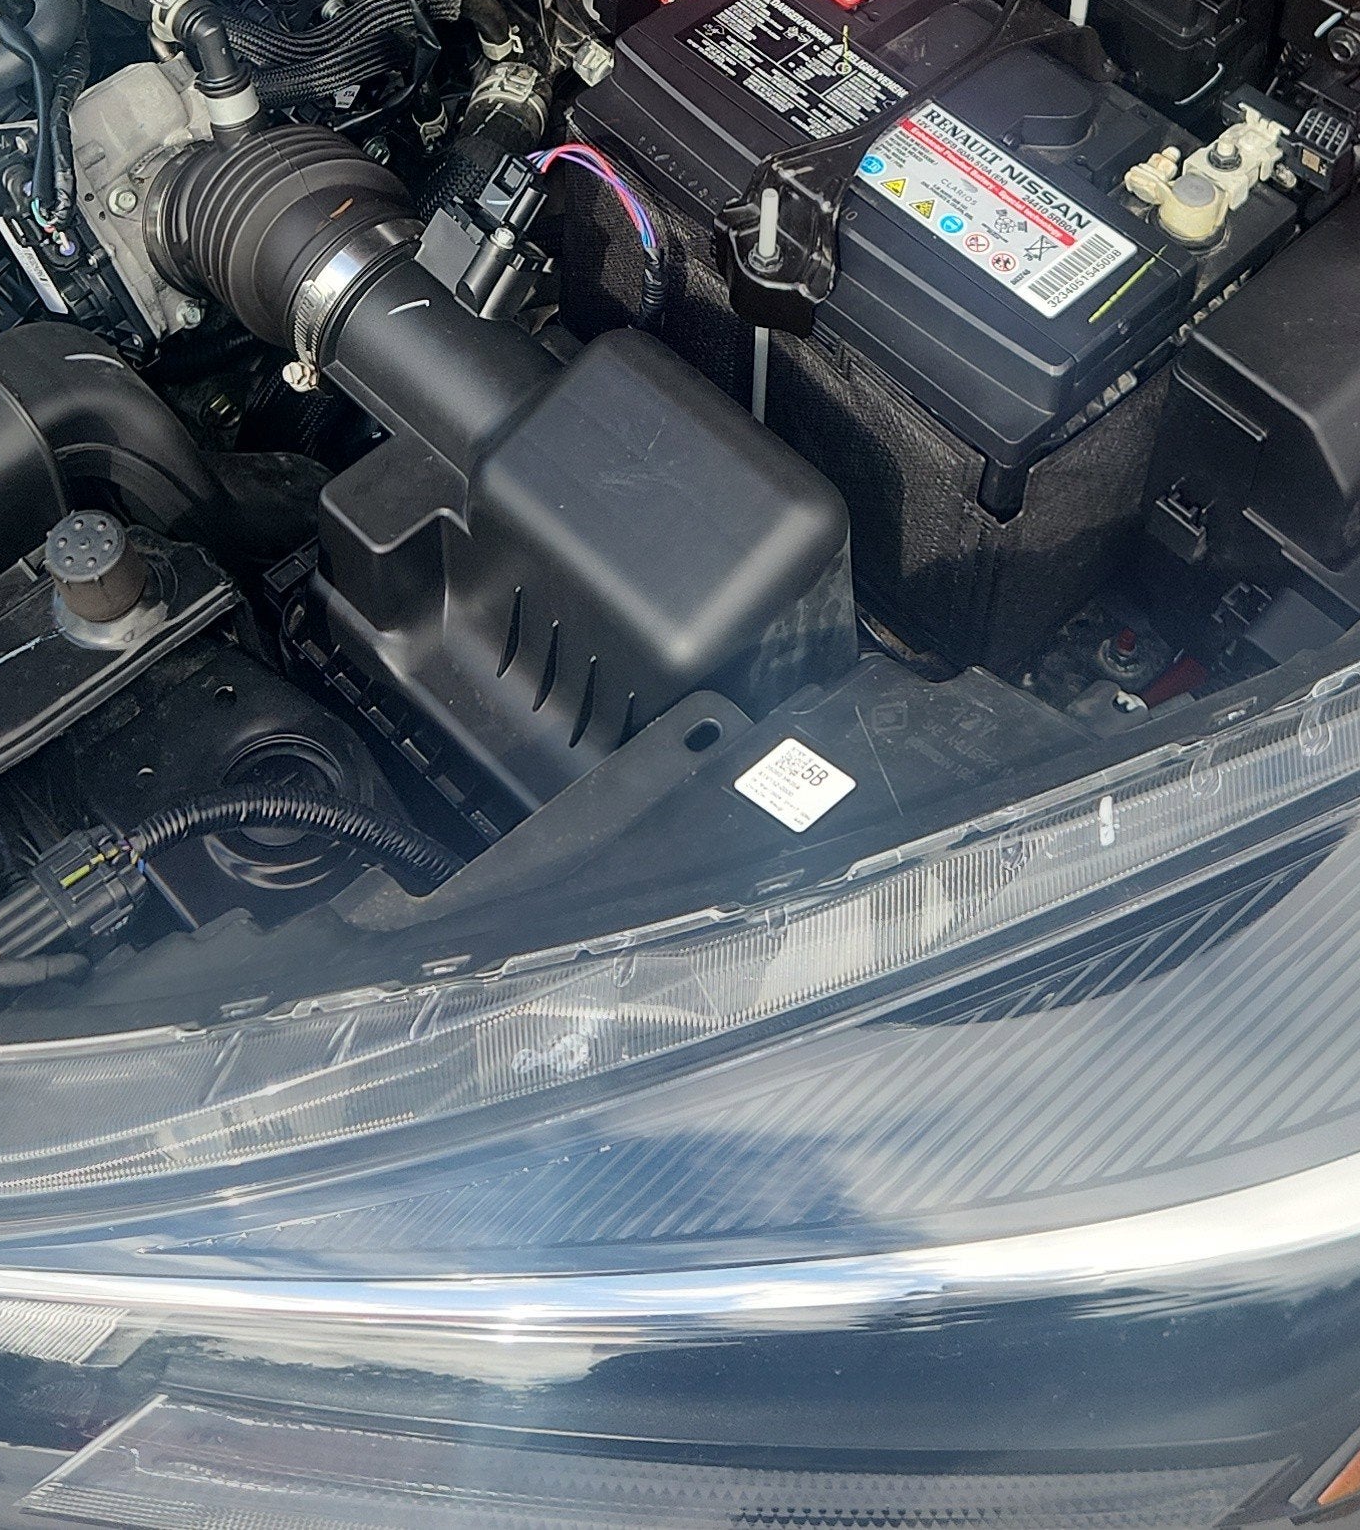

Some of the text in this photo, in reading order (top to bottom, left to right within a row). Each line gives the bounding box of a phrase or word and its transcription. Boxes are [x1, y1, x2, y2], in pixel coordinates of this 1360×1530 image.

[914, 118, 929, 130] 12V
[989, 172, 1009, 186] (EN)
[920, 107, 1003, 166] RENAULT
[999, 162, 1092, 231] NISSAN
[938, 177, 978, 206] CLARIOS
[1021, 193, 1049, 215] 24410
[799, 762, 830, 787] 5B
